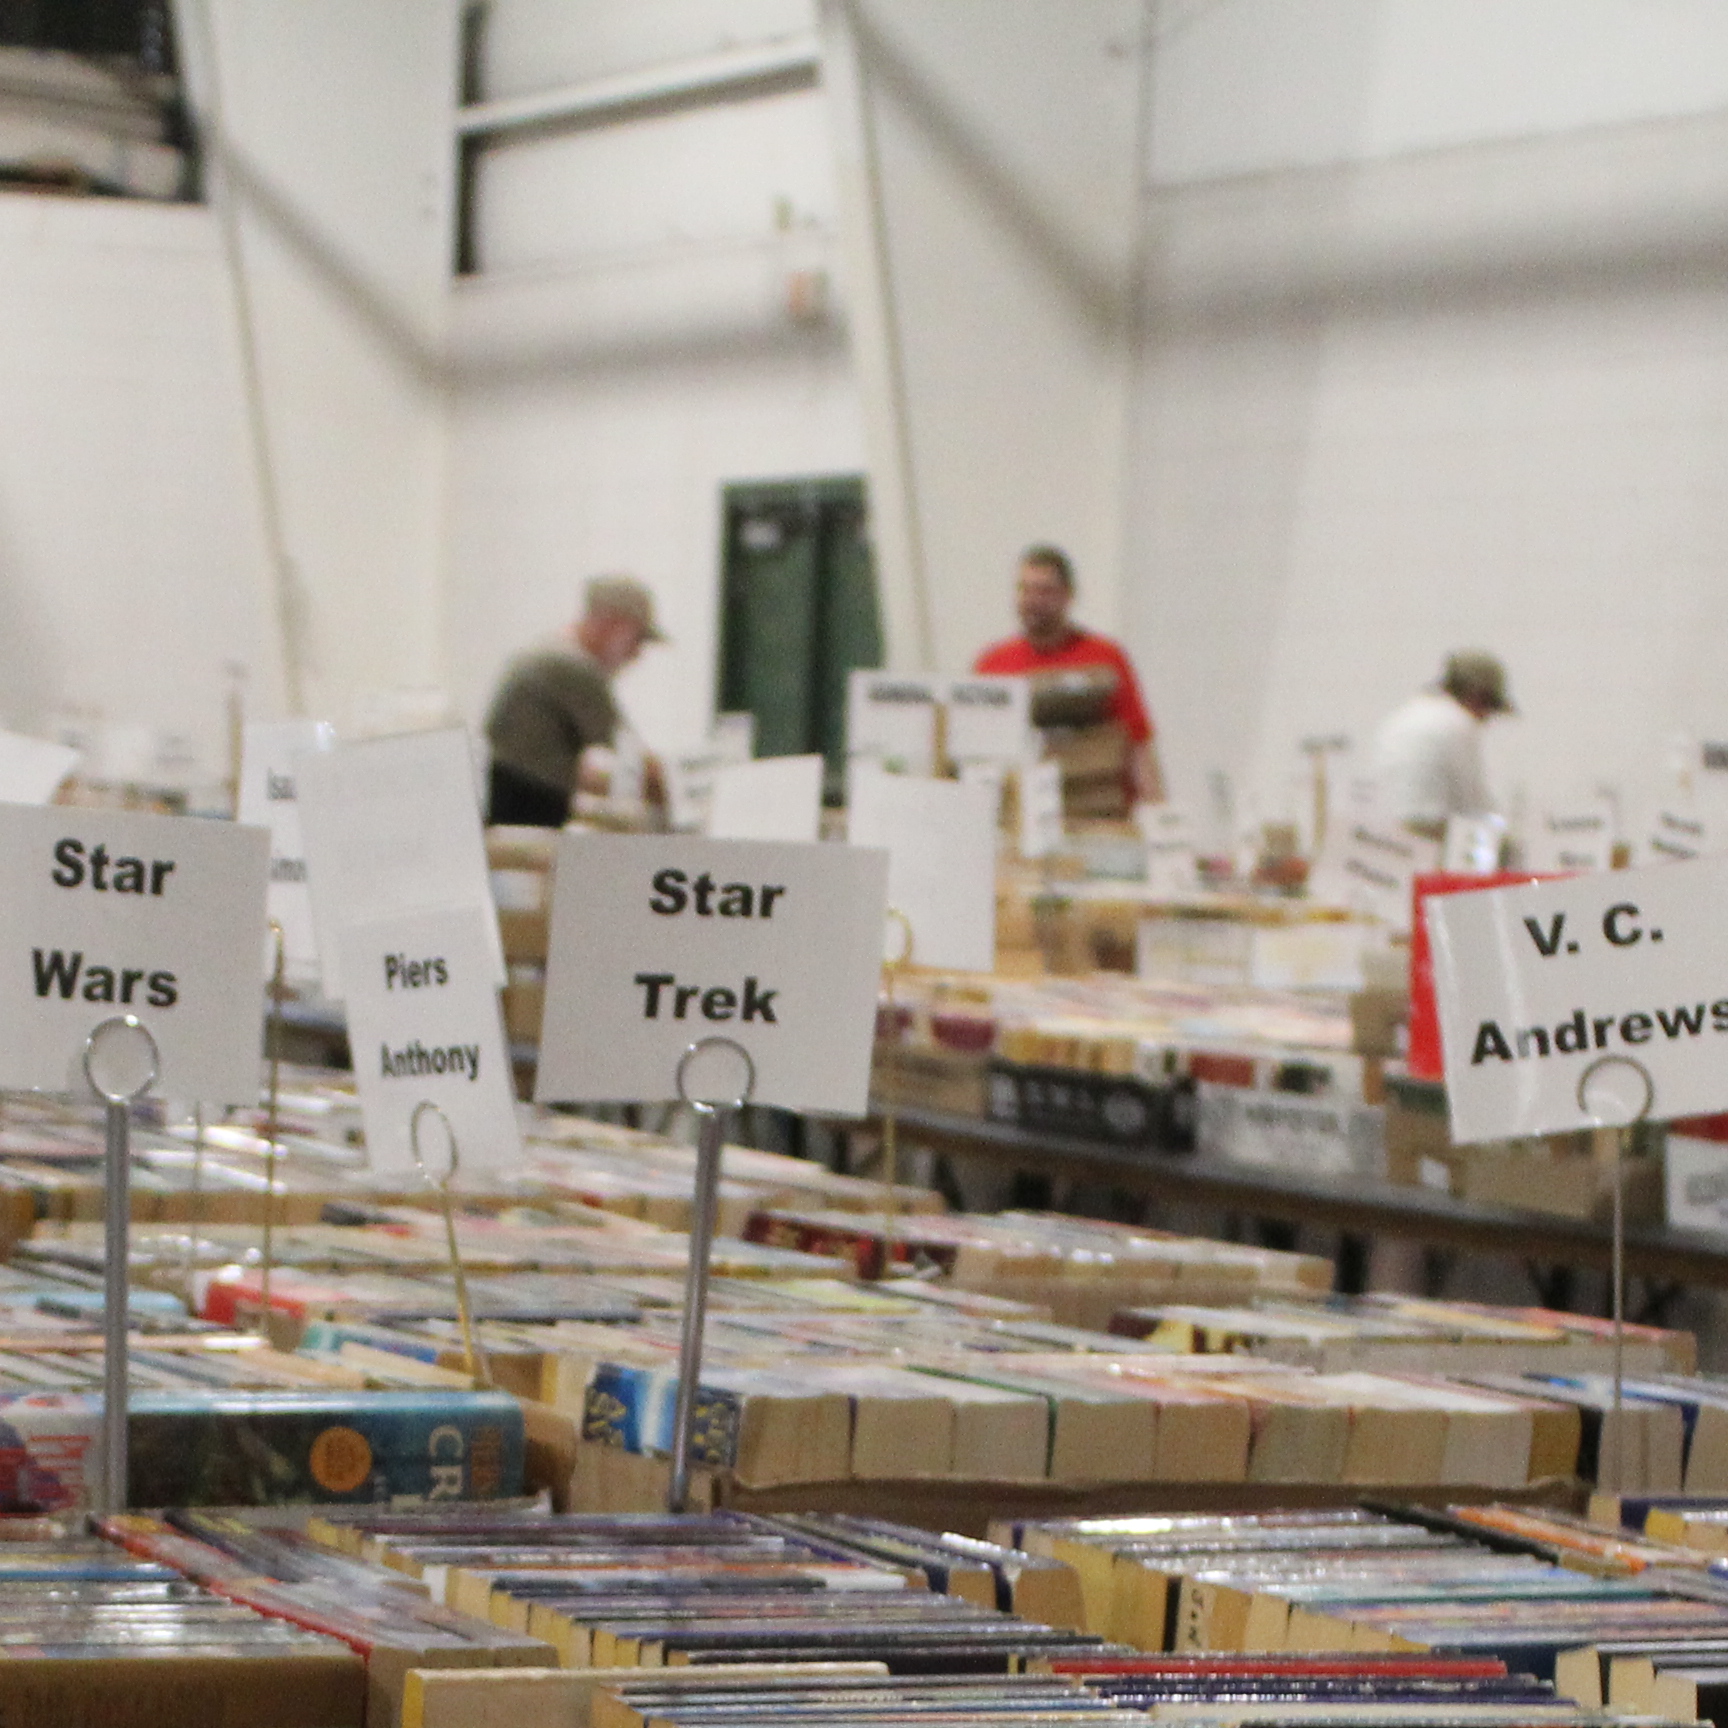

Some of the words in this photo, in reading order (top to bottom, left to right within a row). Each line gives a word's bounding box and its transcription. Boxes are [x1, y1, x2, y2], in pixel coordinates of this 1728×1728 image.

[51, 837, 176, 896] Star
[649, 868, 785, 919] Star
[1523, 912, 1578, 959] V.
[1602, 903, 1665, 949] C.
[31, 949, 179, 1009] Wars
[383, 953, 449, 992] Piers
[634, 973, 778, 1023] Trek
[379, 1040, 481, 1082] Anthony
